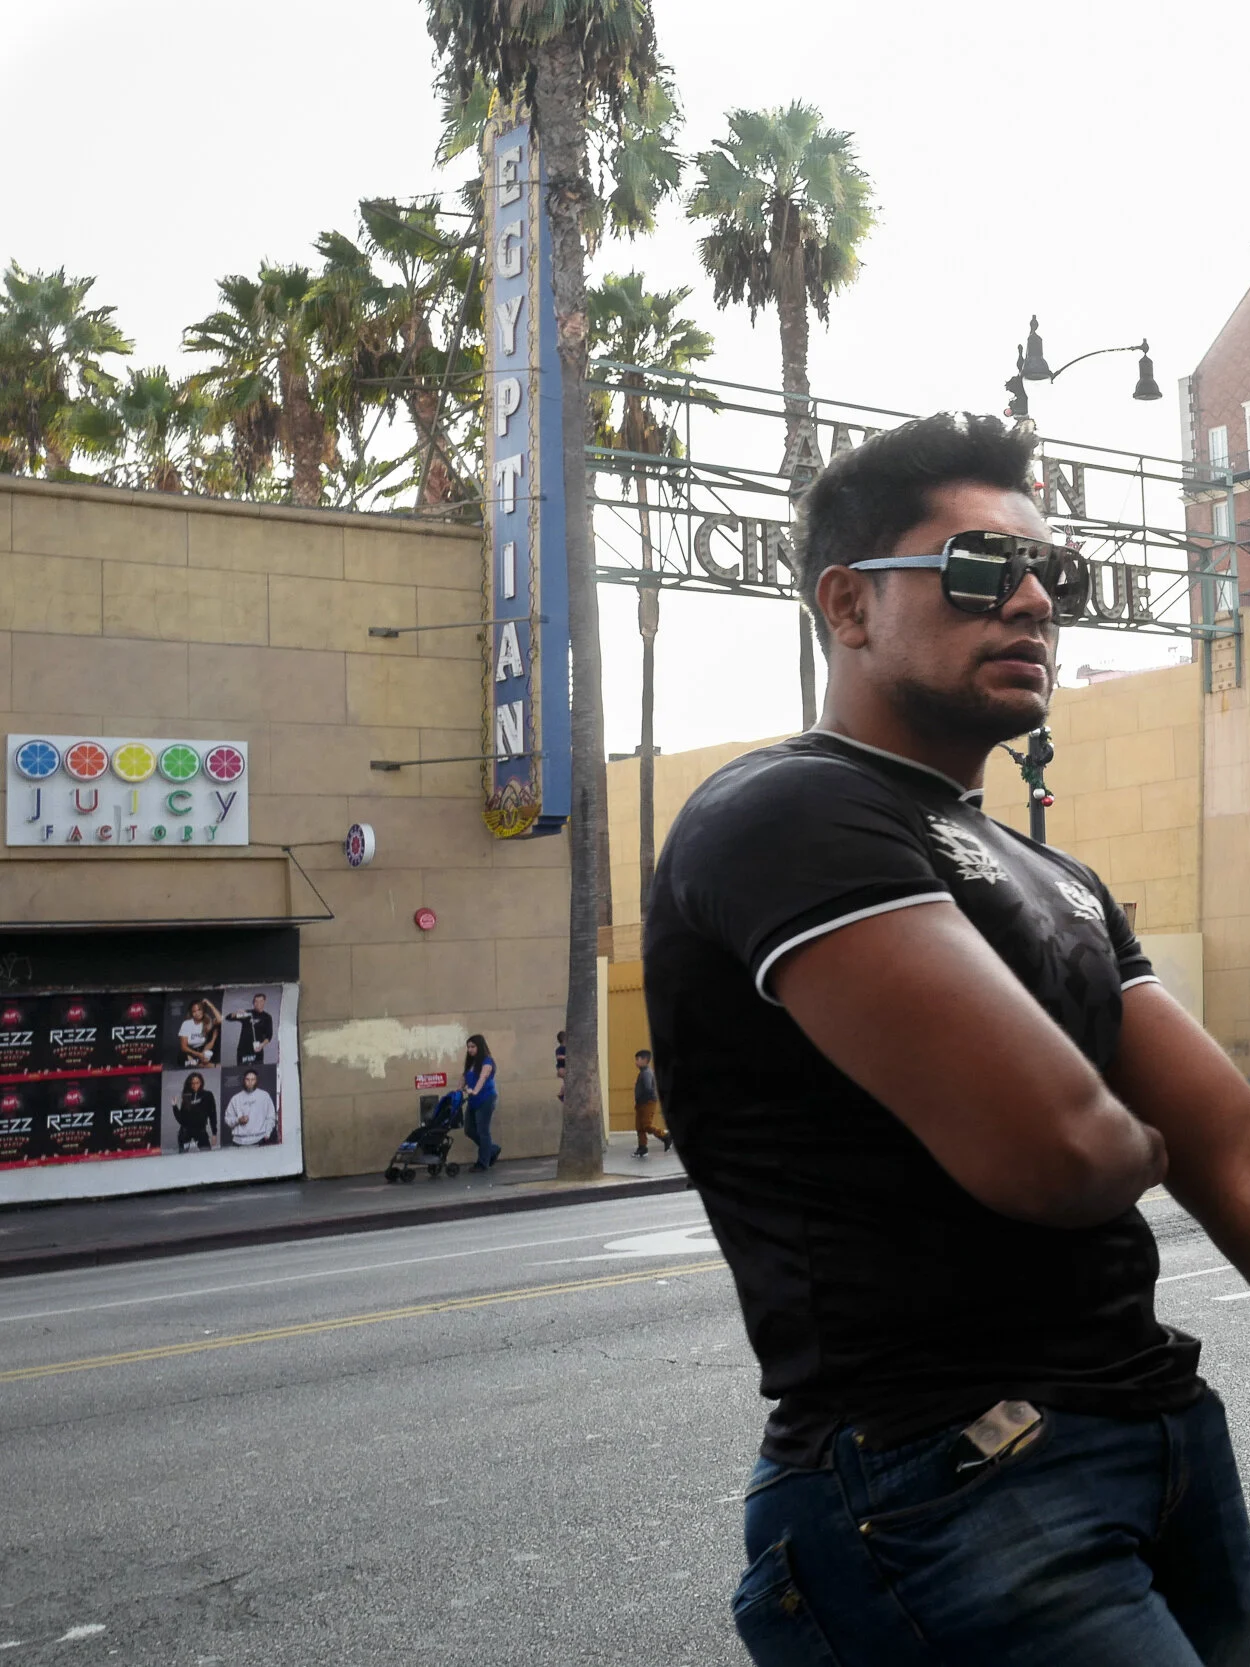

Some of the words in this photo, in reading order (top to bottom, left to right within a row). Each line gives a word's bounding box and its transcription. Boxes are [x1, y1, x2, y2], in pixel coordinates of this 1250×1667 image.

[493, 145, 524, 763] EGYPTIAN
[28, 788, 237, 822] JUICY
[44, 824, 218, 841] FACTORY
